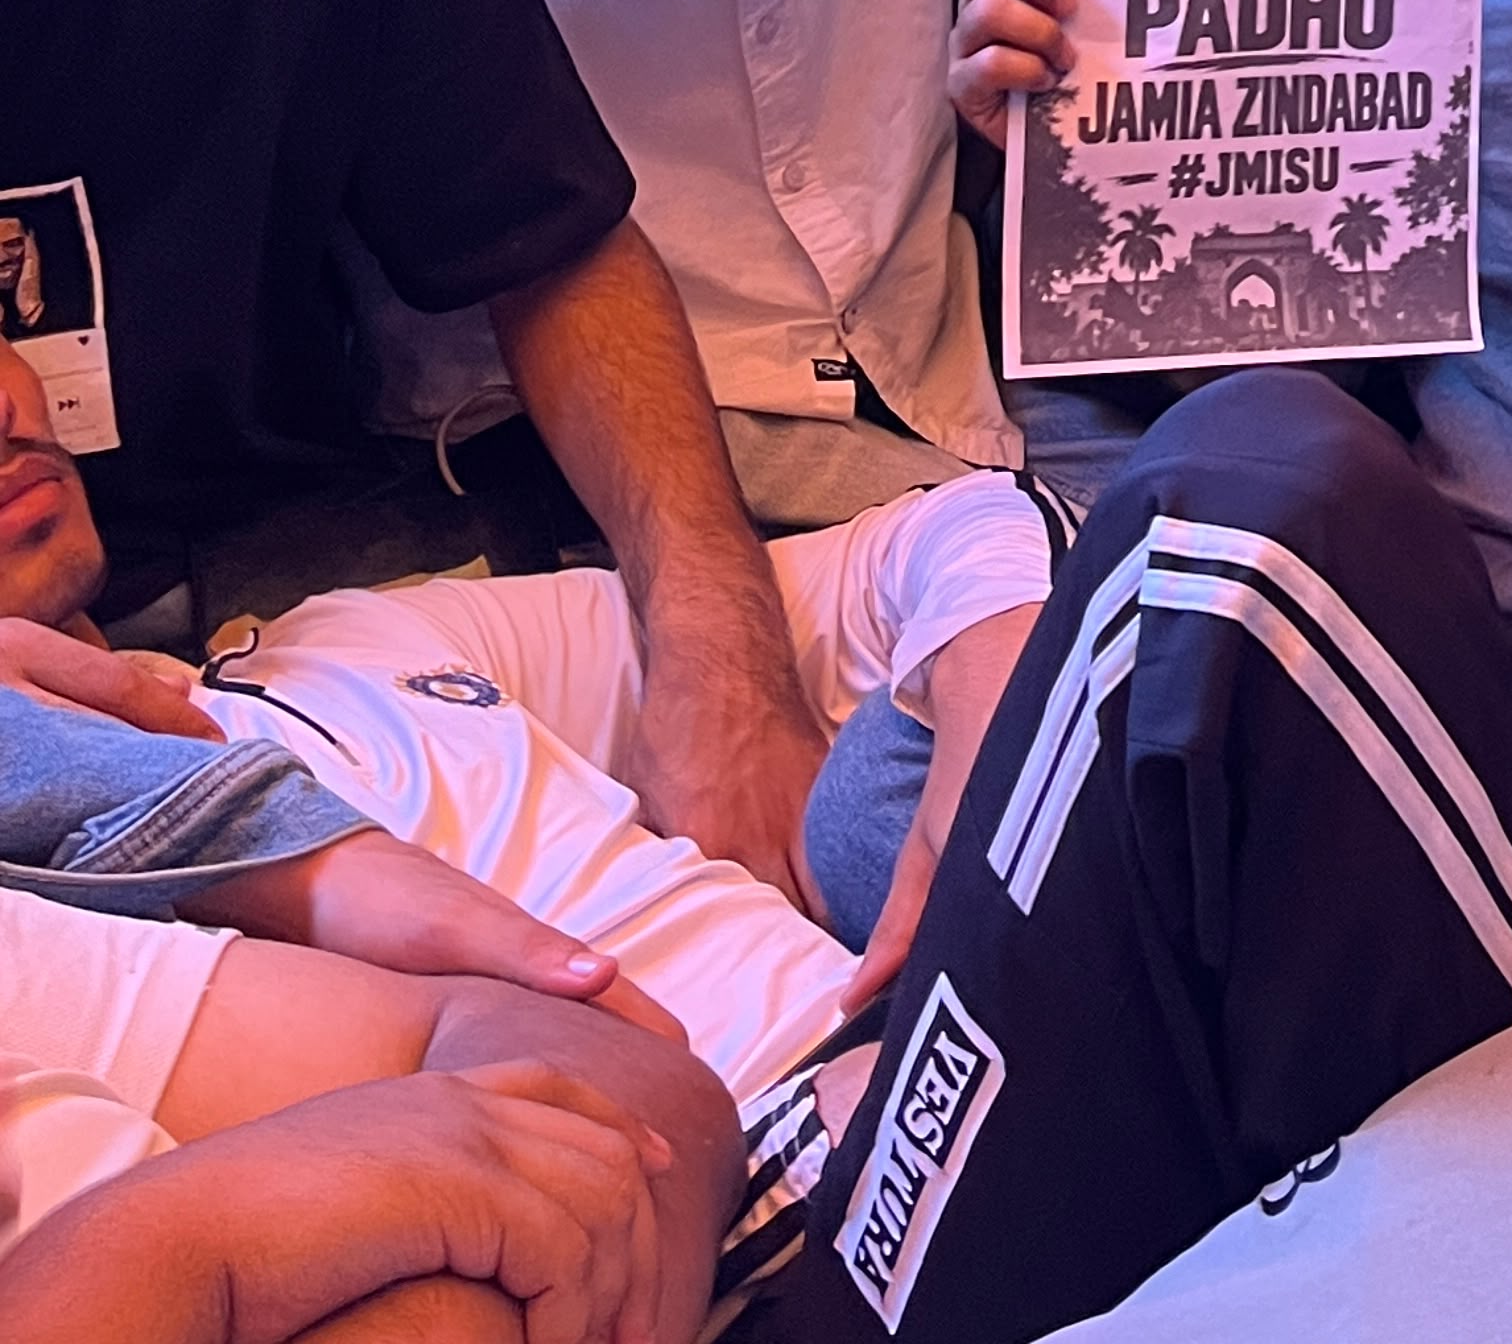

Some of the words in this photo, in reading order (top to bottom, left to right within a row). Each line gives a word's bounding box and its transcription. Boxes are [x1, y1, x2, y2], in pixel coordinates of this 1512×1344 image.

[1078, 78, 1222, 144] JAMIA
[1232, 71, 1433, 138] ZINDABAD
[1168, 146, 1340, 199] #JMISU
